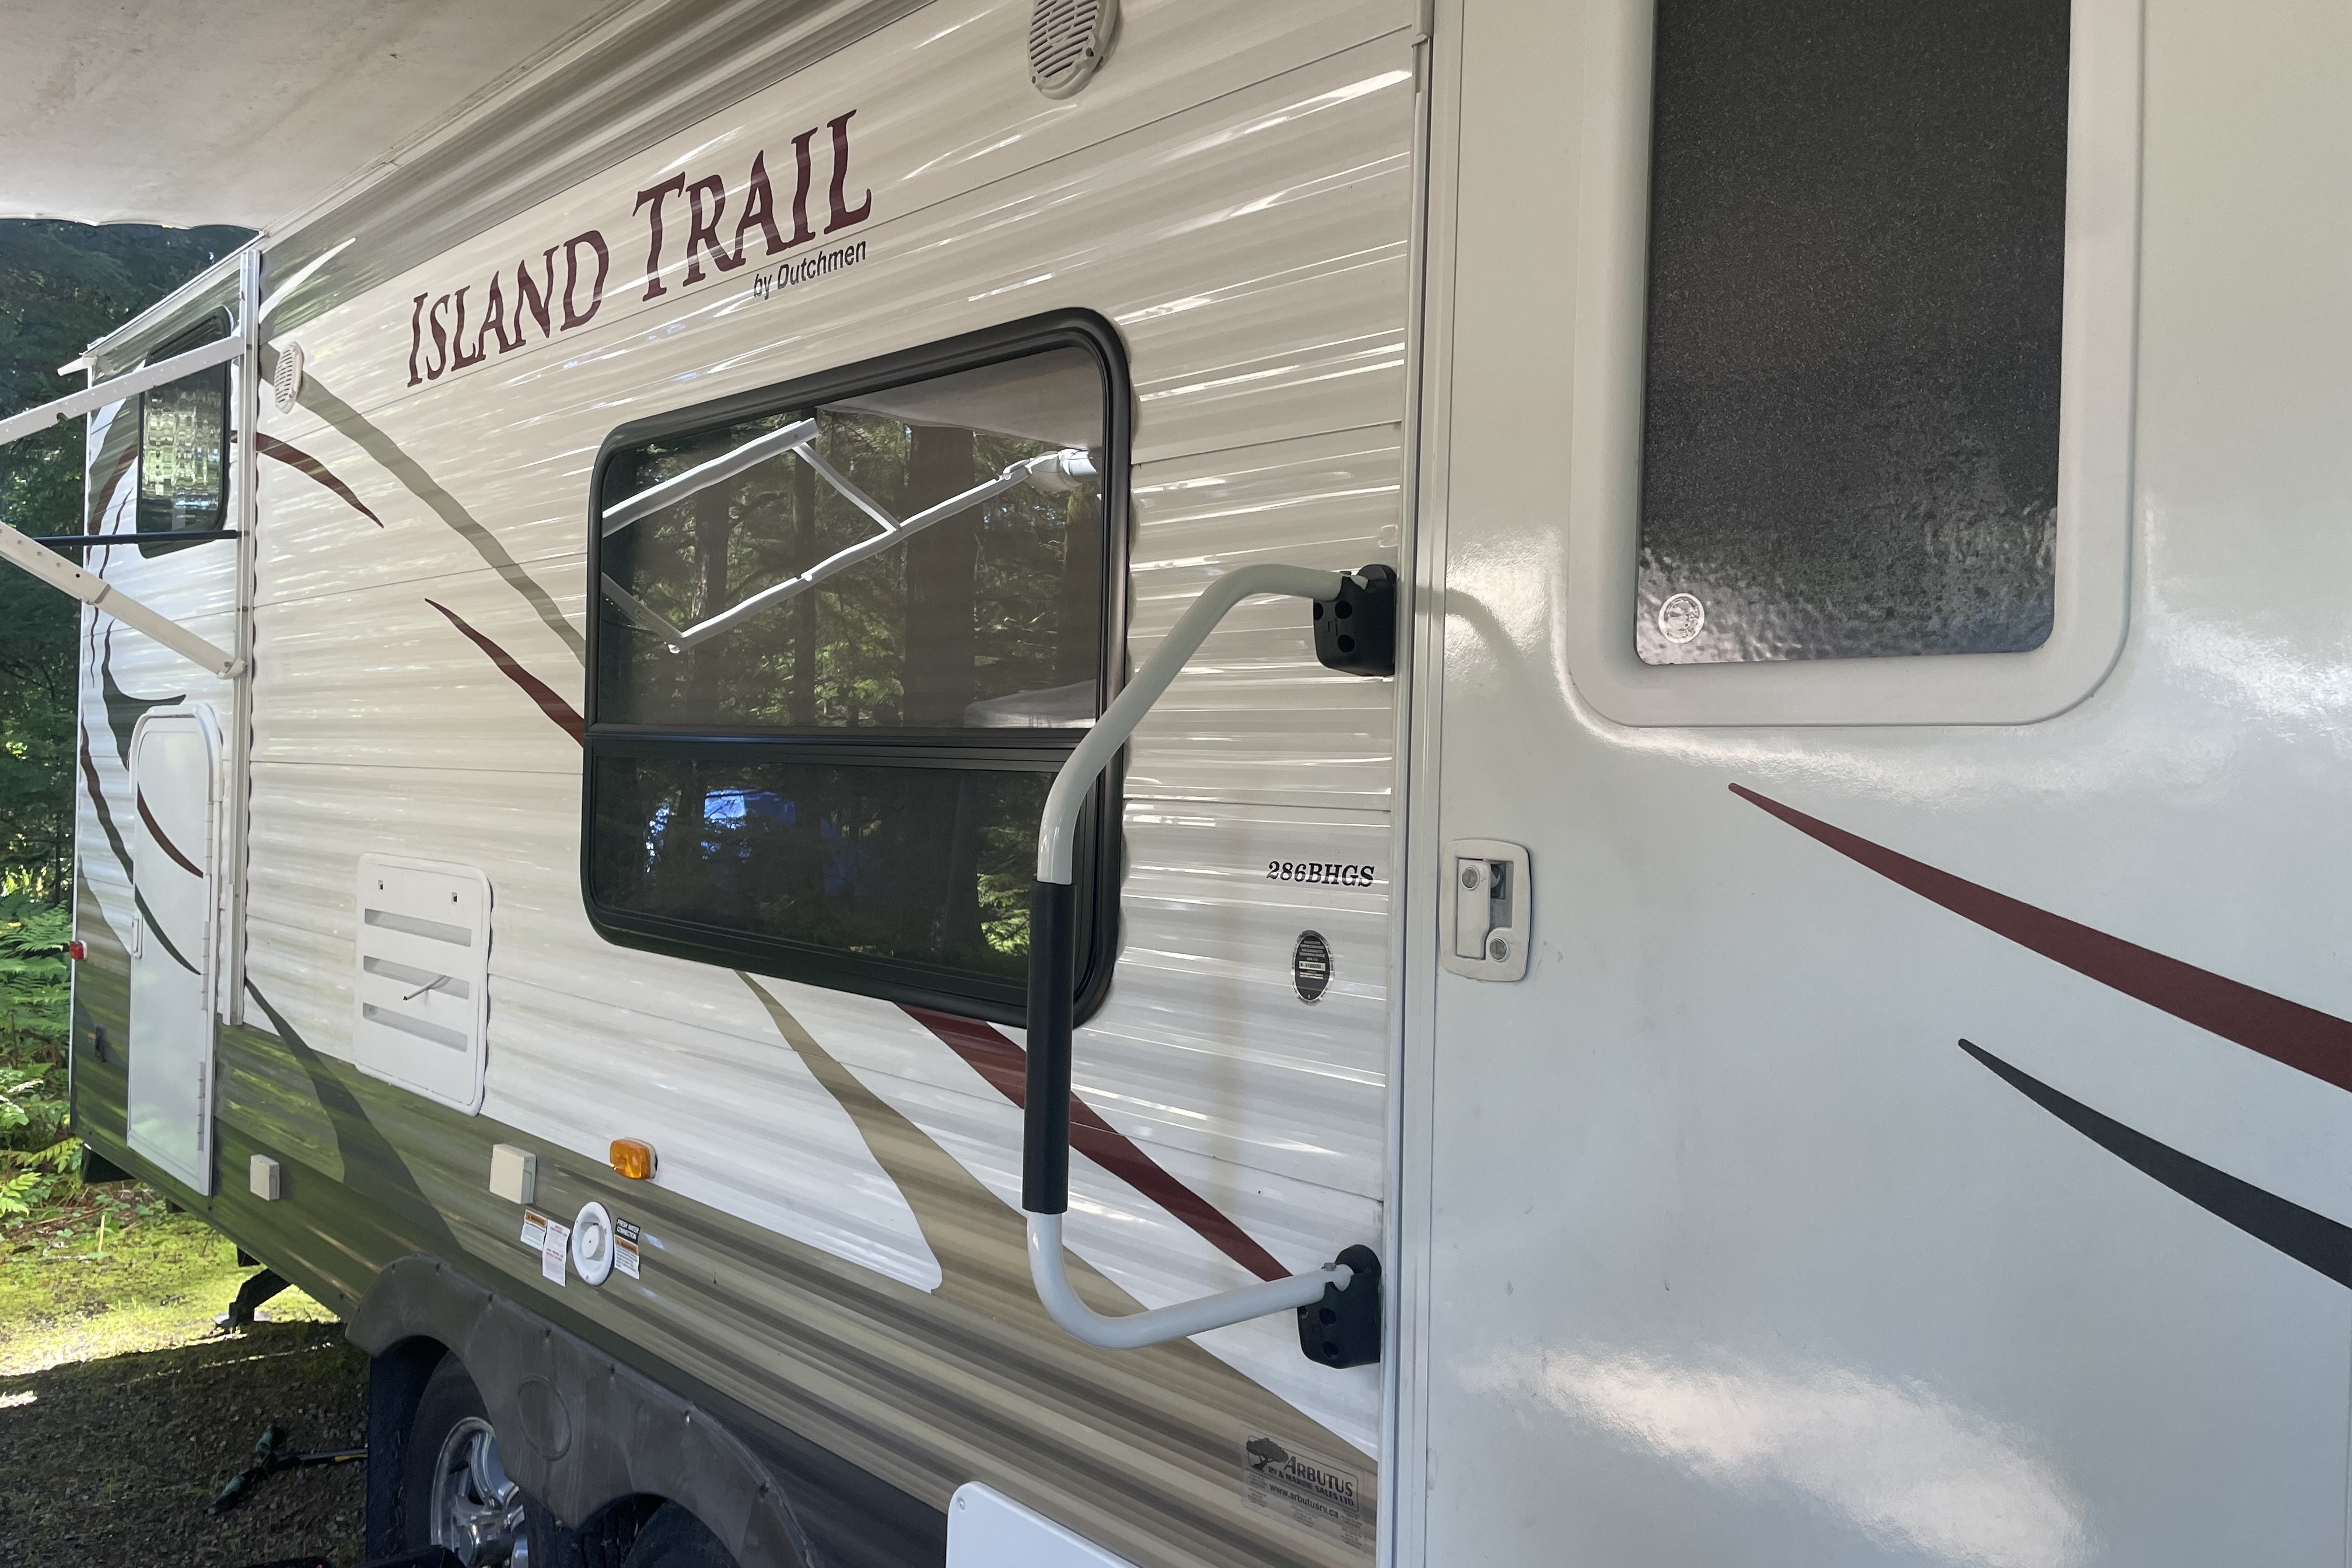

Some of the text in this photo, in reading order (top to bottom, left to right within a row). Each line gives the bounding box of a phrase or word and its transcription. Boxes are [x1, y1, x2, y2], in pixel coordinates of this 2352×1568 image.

[407, 109, 871, 387] ISLAND TRAIL
[754, 241, 866, 300] by Dutchmen
[1266, 860, 1375, 887] 286BHGS
[1268, 1466, 1354, 1506] RV & MARINE SALES LTD
[1283, 1456, 1353, 1497] ARBUTUS
[1269, 1483, 1339, 1518] www.arbutusrv.ca
